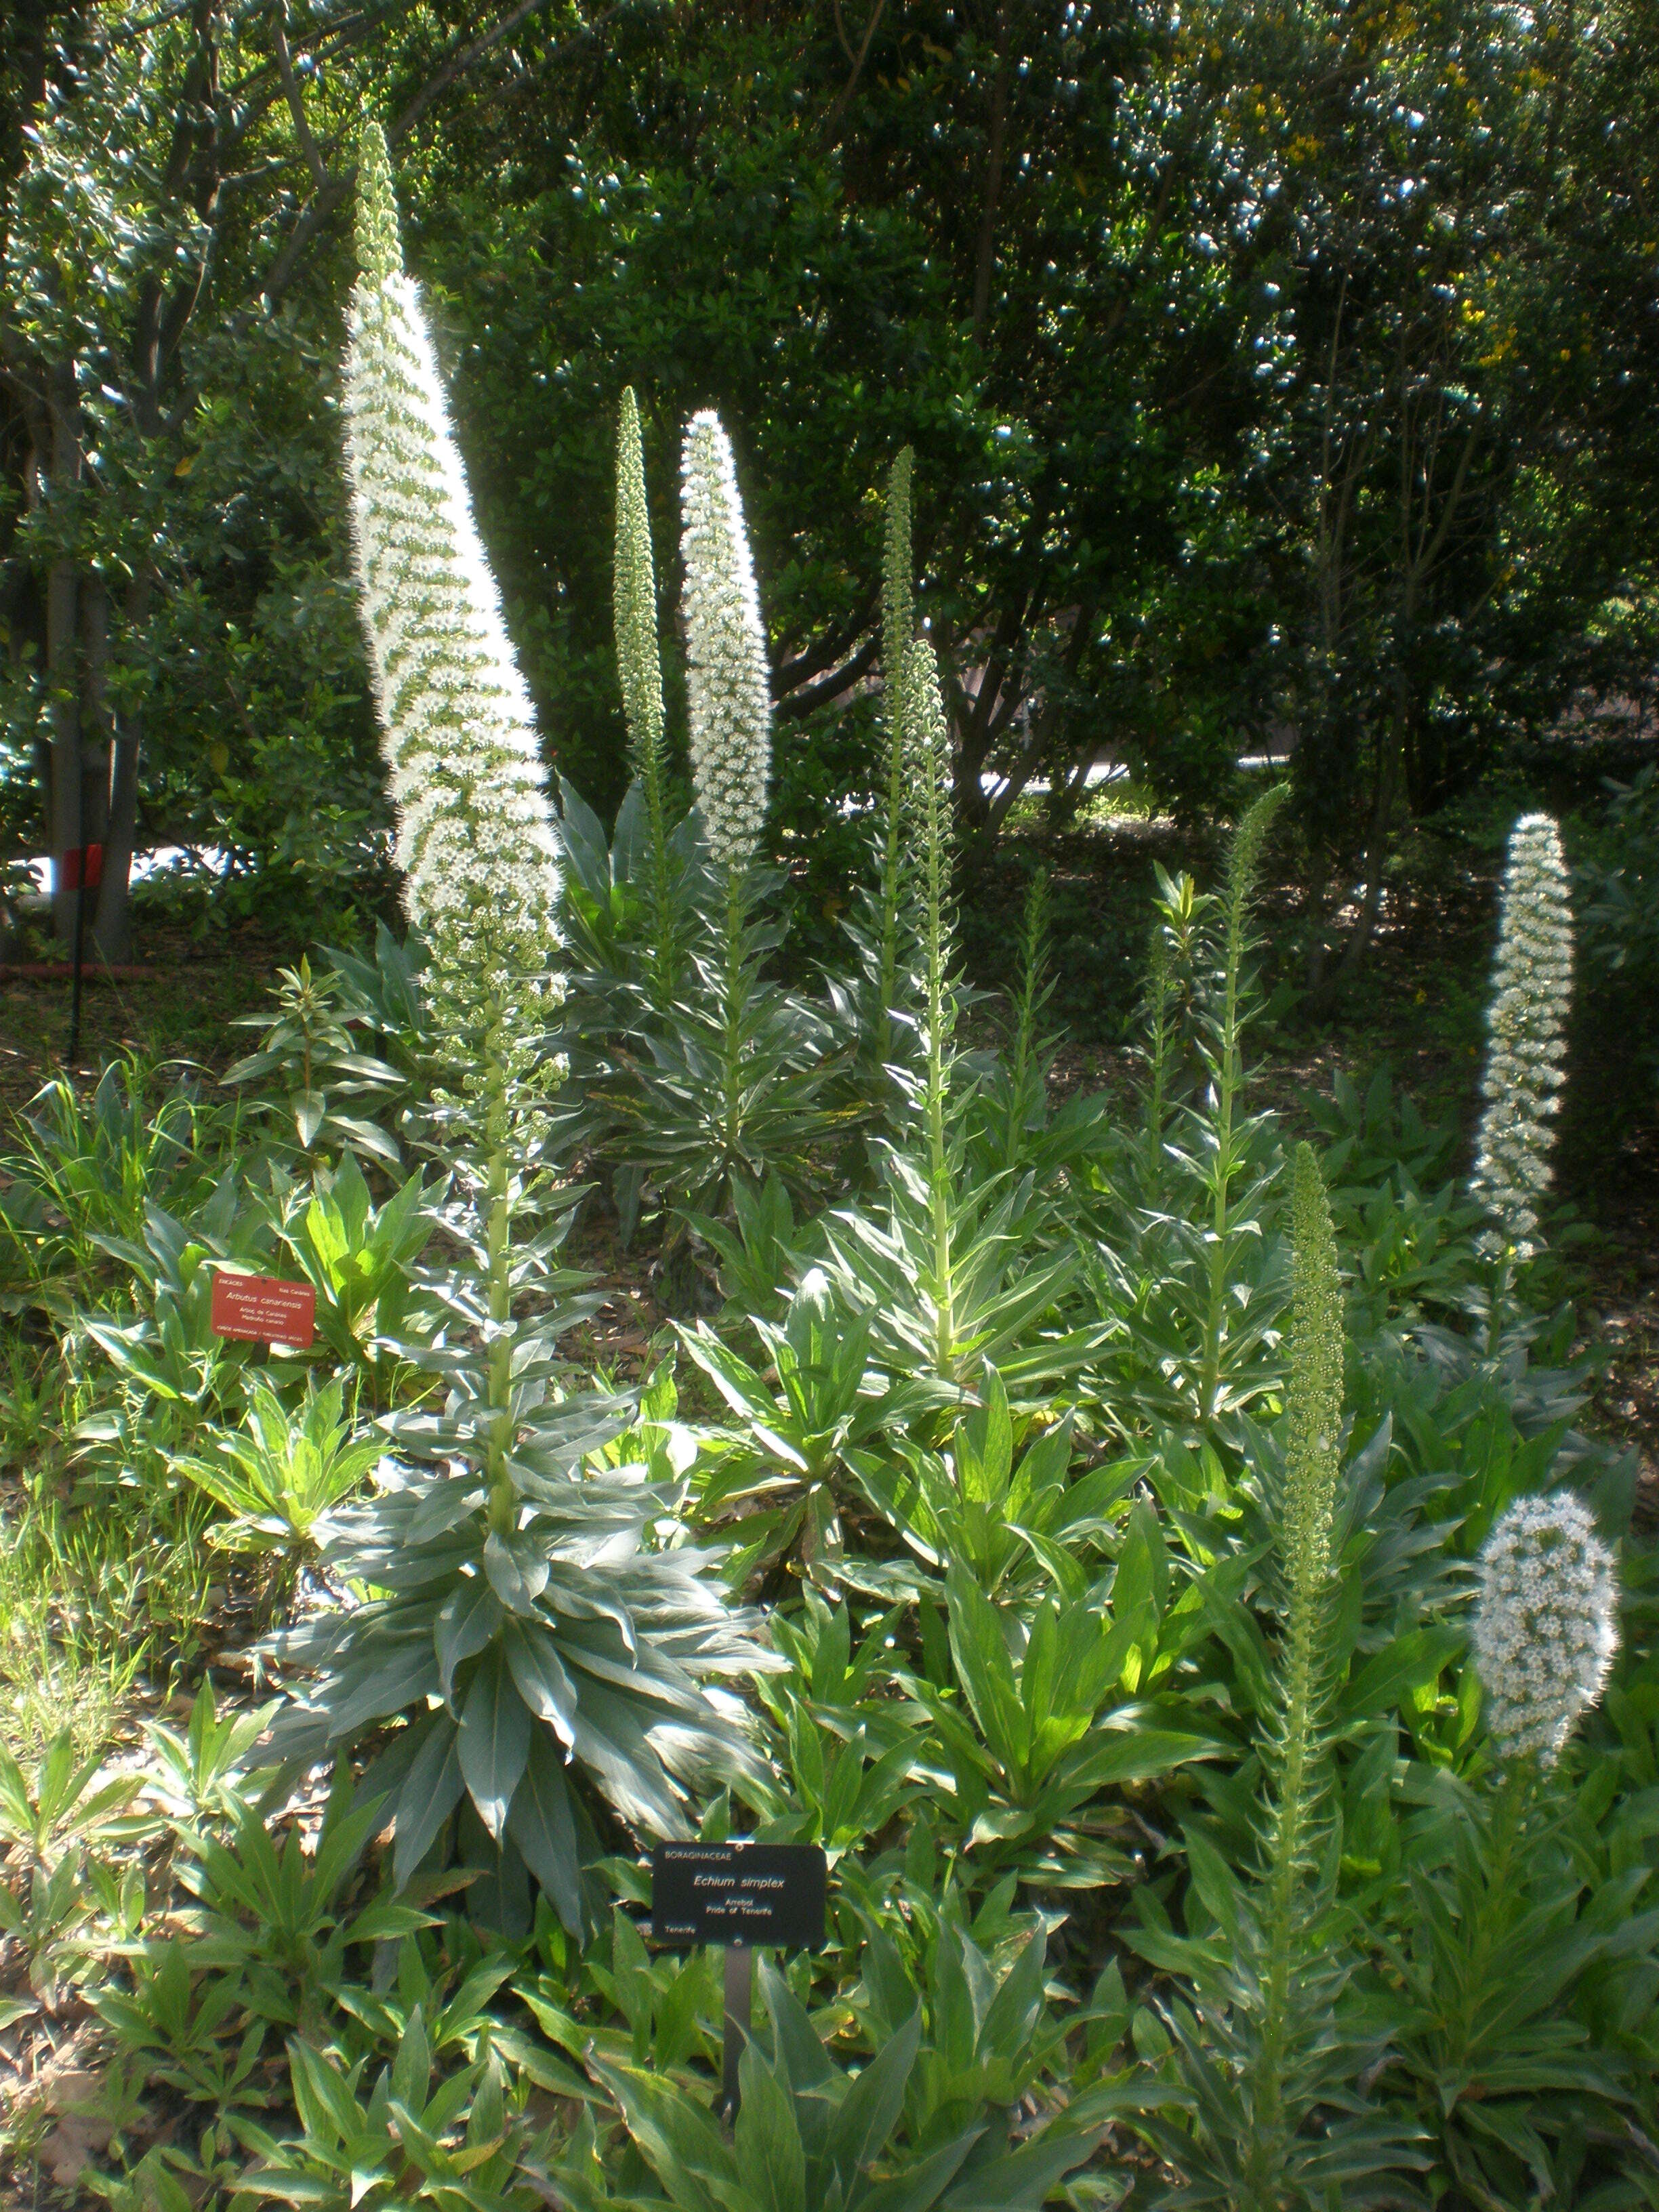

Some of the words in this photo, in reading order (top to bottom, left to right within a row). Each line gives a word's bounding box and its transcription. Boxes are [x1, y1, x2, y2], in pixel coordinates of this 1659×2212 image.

[226, 1292, 257, 1303] Arbutus
[260, 1298, 302, 1309] canariensis
[664, 1851, 732, 1861] BORAGINACEAE
[693, 1875, 735, 1887] Echium
[740, 1876, 785, 1891] simplex
[705, 1906, 725, 1914] Pride
[729, 1906, 738, 1914] of
[741, 1907, 772, 1916] Tenerife
